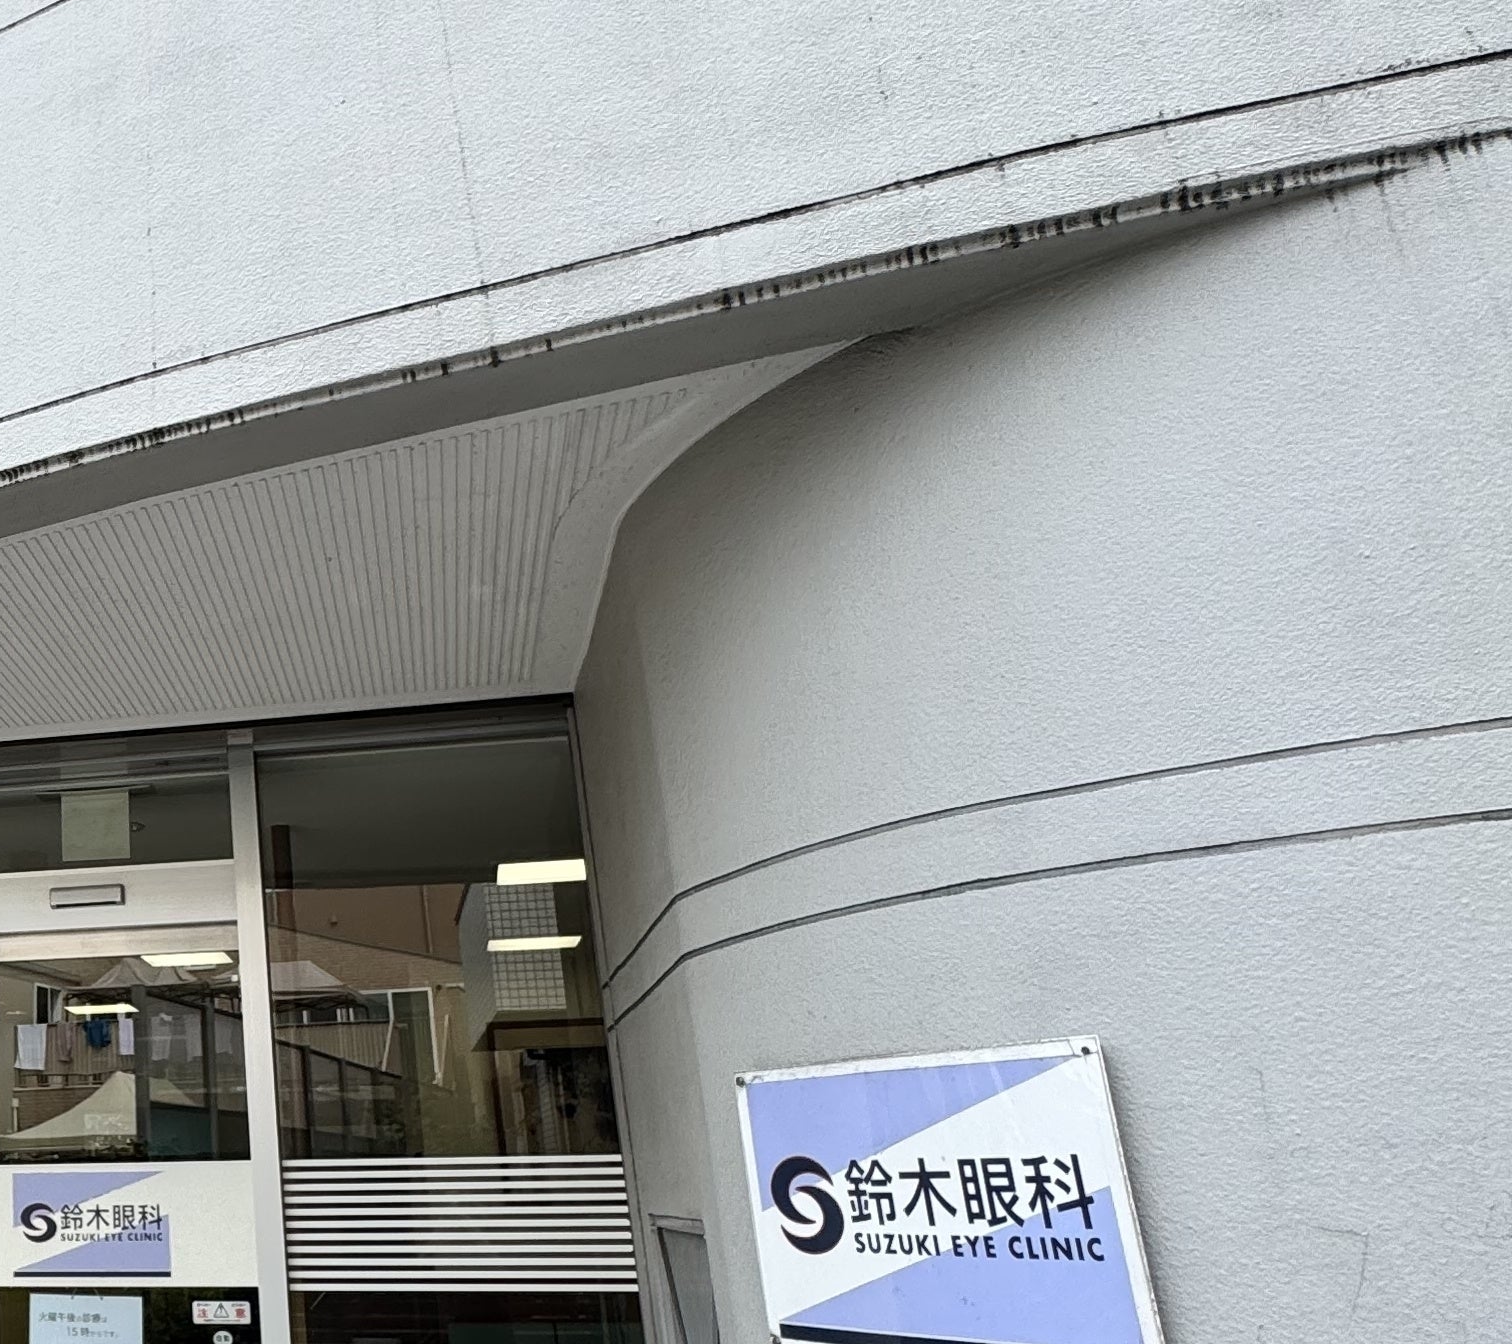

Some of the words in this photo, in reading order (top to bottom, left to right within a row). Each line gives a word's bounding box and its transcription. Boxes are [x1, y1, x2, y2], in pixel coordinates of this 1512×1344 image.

[844, 1154, 1095, 1230] 鈴木眼科
[60, 1204, 163, 1230] 鈴木眼科
[60, 1233, 100, 1242] SUZUKI
[105, 1233, 123, 1242] EYE
[127, 1232, 163, 1242] CLINIC
[855, 1233, 941, 1257] SUZUKI
[952, 1235, 997, 1258] EYE
[1009, 1235, 1105, 1262] CLINIC
